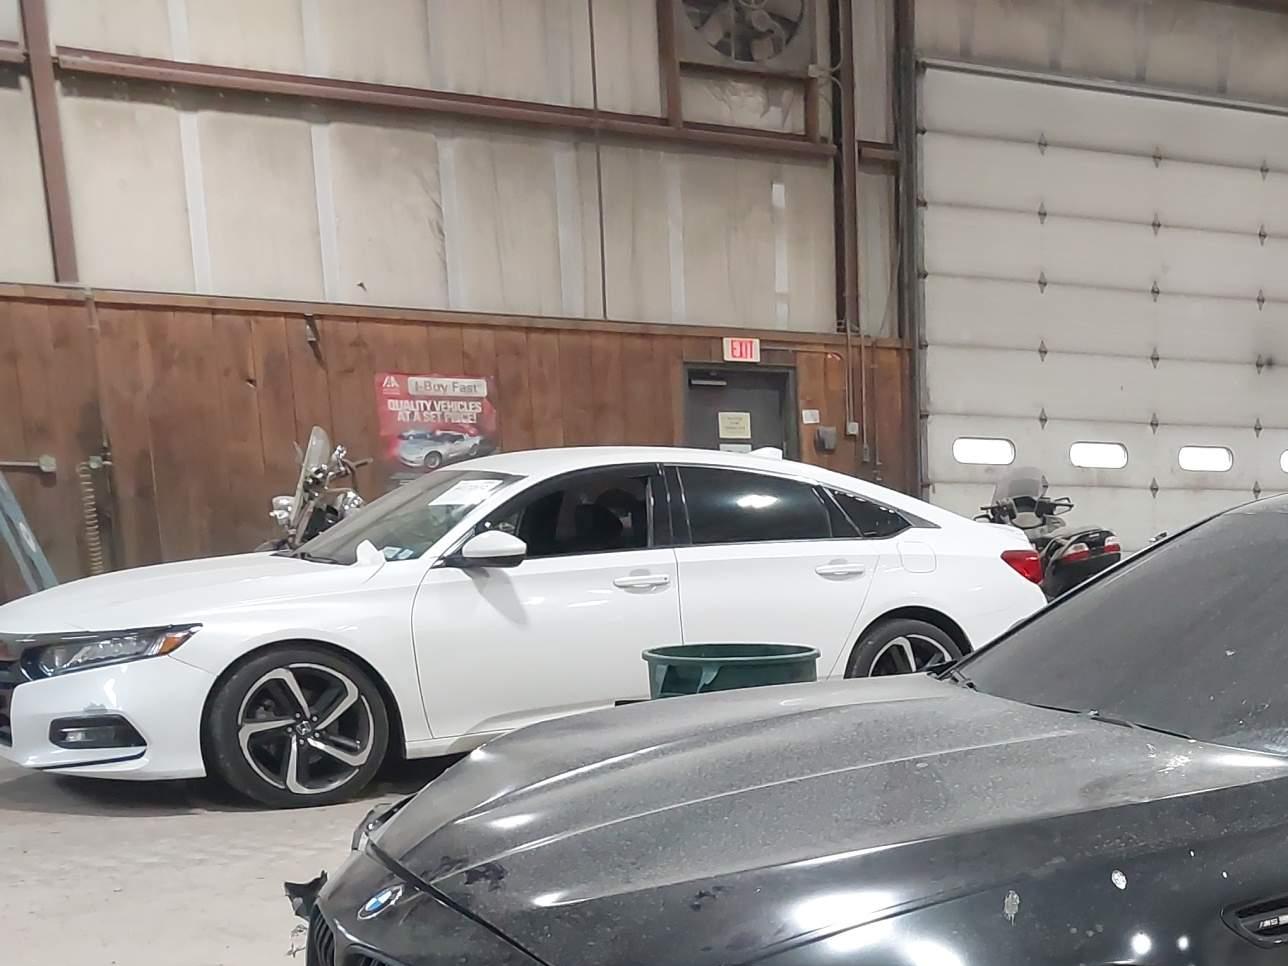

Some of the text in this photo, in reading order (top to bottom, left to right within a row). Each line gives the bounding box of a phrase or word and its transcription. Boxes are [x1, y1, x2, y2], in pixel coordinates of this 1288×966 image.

[414, 381, 448, 394] I-Buy
[452, 382, 477, 393] Fast
[387, 399, 482, 413] QUALITY VEHICLES
[397, 411, 411, 422] AT
[412, 411, 421, 422] A
[423, 411, 441, 423] SET
